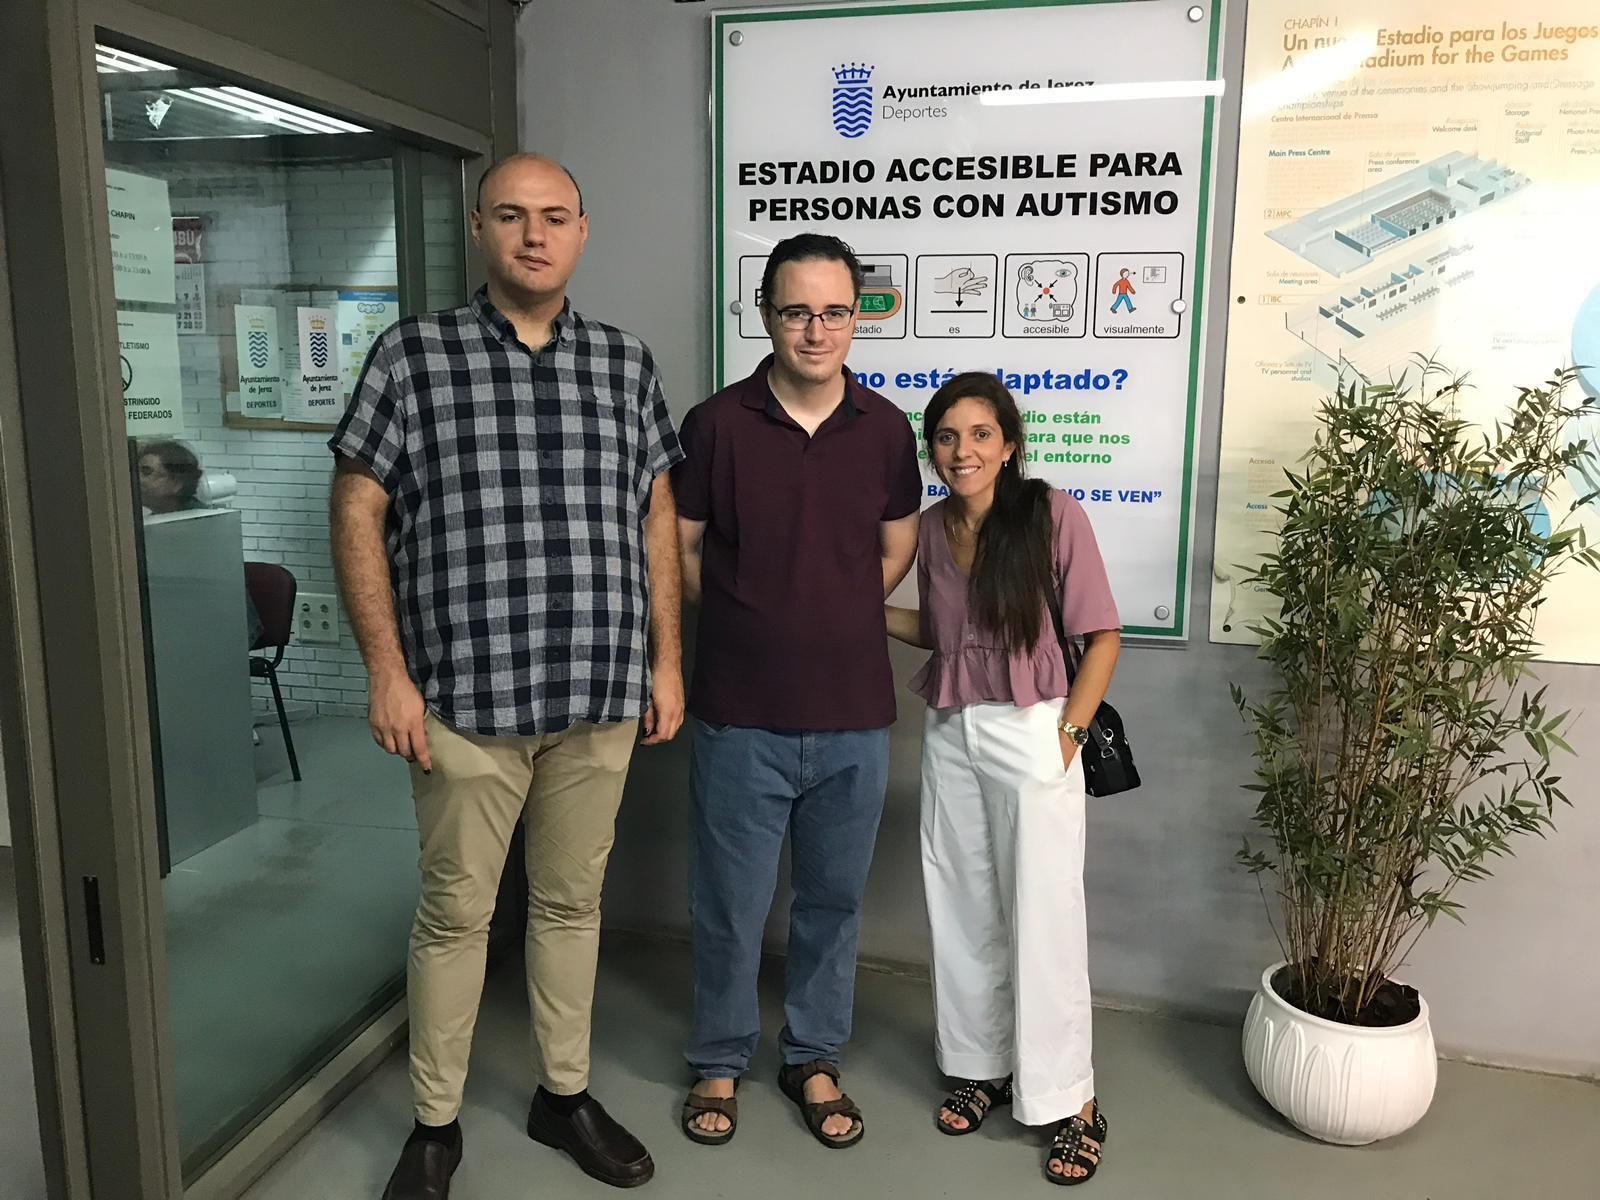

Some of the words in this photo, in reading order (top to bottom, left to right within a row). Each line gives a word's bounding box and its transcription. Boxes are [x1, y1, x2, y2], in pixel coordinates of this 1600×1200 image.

[1283, 33, 1308, 51] Un
[1376, 24, 1444, 46] Estadio
[1449, 29, 1495, 48] para
[1501, 21, 1528, 41] los
[1533, 22, 1599, 44] Juegos
[1361, 48, 1425, 69] adium
[1431, 45, 1459, 65] for
[1465, 44, 1495, 64] the
[1501, 44, 1569, 62] Games
[882, 82, 1012, 102] Ayuntamiento
[1361, 86, 1375, 96] the
[882, 105, 947, 122] Deportes
[1268, 149, 1286, 157] Main
[1288, 149, 1306, 157] Press
[1307, 148, 1331, 156] Centre
[738, 159, 876, 186] ESTADIO
[885, 154, 1077, 182] ACCESIBLE
[1089, 151, 1183, 178] PARA
[748, 194, 922, 222] PERSONAS
[932, 193, 1005, 218] CON
[1015, 190, 1179, 217] AUTISMO
[854, 325, 882, 334] stadio
[948, 326, 961, 334] es
[1023, 324, 1070, 334] accesible
[1103, 324, 1165, 334] visualmente
[119, 341, 150, 350] TLETISMO
[240, 375, 280, 385] Ayuntamiento
[302, 374, 338, 383] Ayuntamiento
[997, 368, 1128, 395] aptado?
[248, 386, 257, 394] de
[258, 385, 273, 395] Jerez
[318, 384, 332, 394] Jerez
[123, 397, 161, 406] STRINGIDO
[246, 401, 277, 409] DEPORTES
[308, 398, 335, 407] DEPORTES
[128, 410, 173, 420] FEDERADOS
[1052, 411, 1101, 424] están
[1061, 433, 1093, 446] que
[1099, 433, 1131, 445] nos
[1043, 451, 1112, 464] entorno
[1090, 489, 1112, 502] SE
